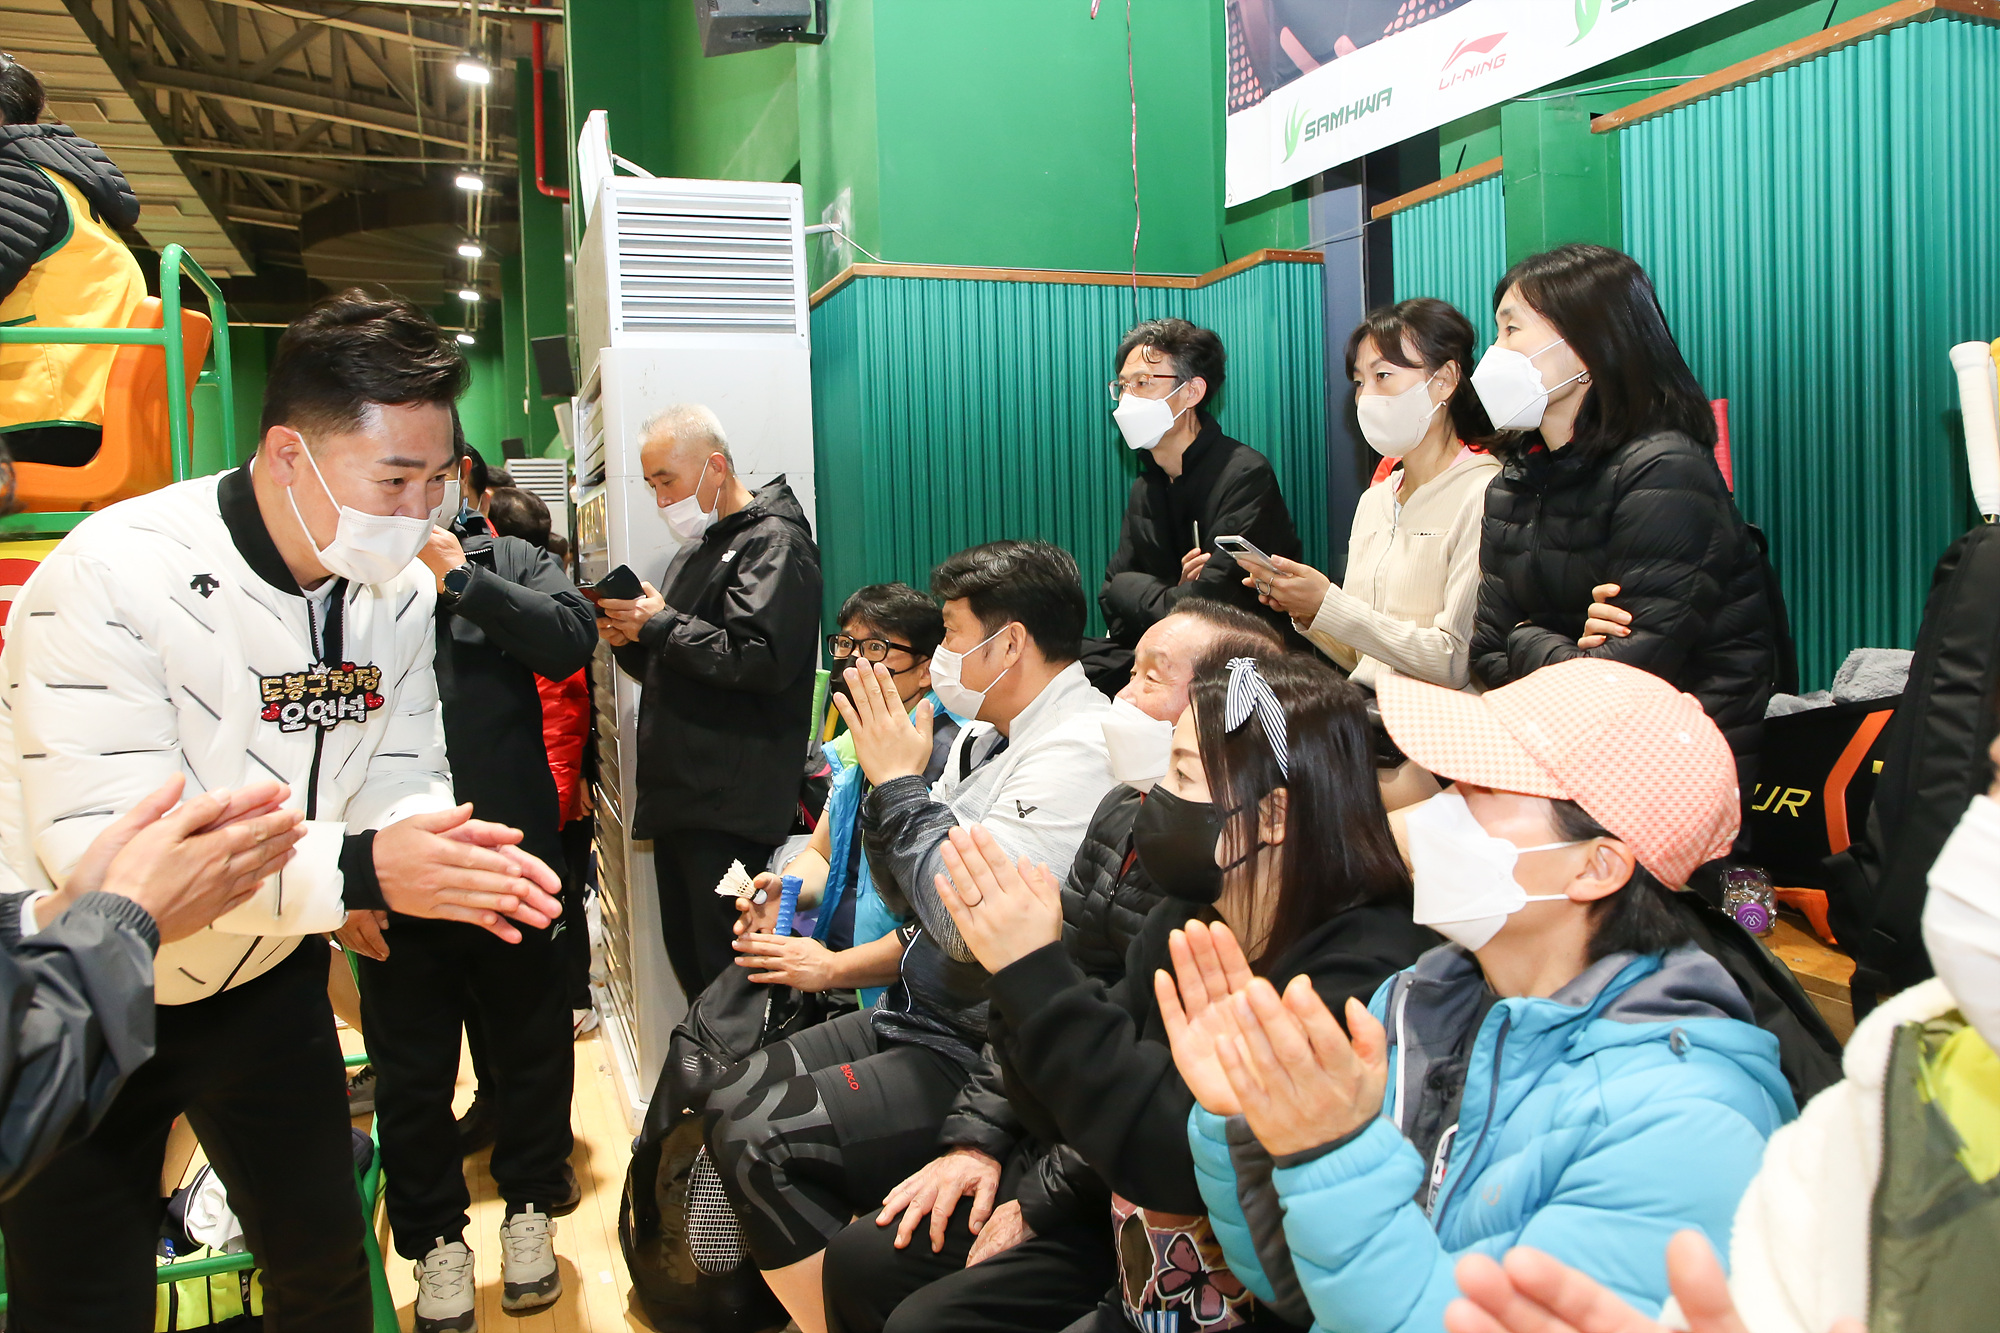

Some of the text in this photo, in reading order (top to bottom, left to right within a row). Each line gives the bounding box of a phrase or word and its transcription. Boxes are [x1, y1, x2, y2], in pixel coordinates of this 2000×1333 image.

[1438, 53, 1507, 91] LI-NING
[1304, 87, 1393, 142] SAMHWA
[261, 667, 381, 702] 도봉구청장
